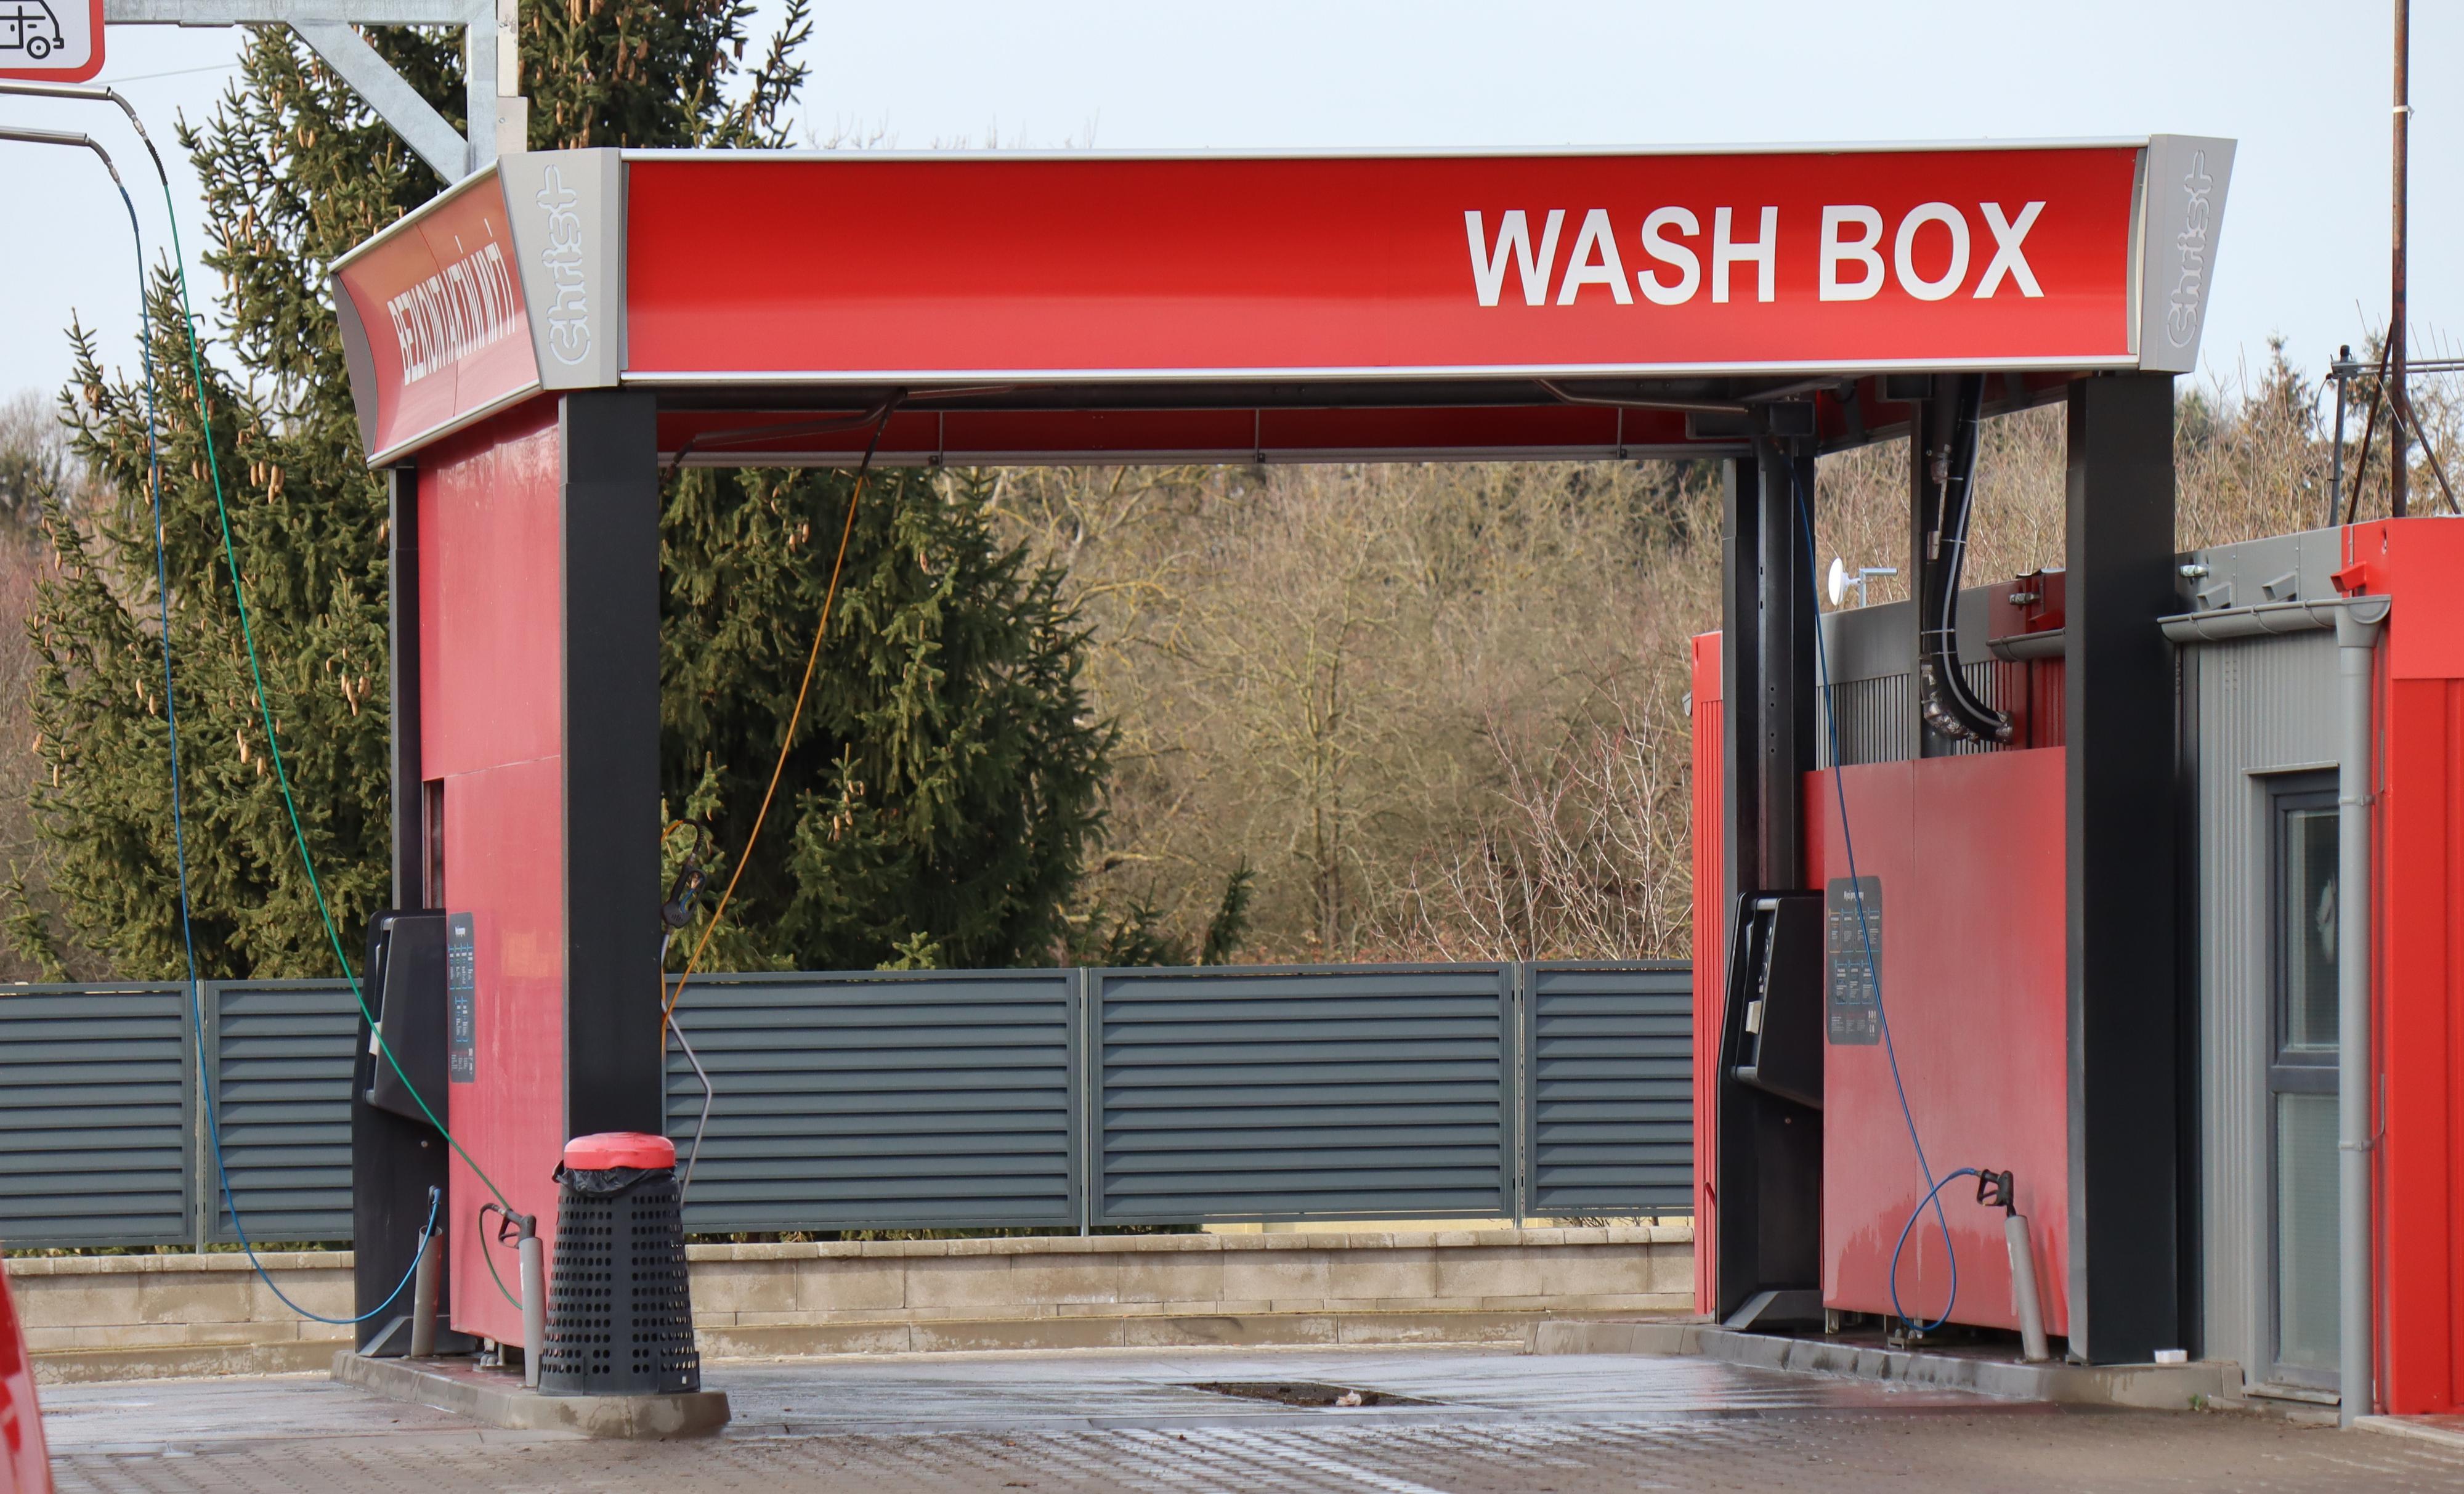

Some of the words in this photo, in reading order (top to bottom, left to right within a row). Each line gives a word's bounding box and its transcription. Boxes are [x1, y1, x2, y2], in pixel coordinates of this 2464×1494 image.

[387, 235, 485, 386] BEZKONTAKTNÍ
[471, 218, 516, 344] MYTÍ
[535, 163, 591, 365] Christ
[1464, 206, 1779, 307] WASH
[1819, 201, 2047, 301] BOX
[2166, 148, 2213, 349] Christ
